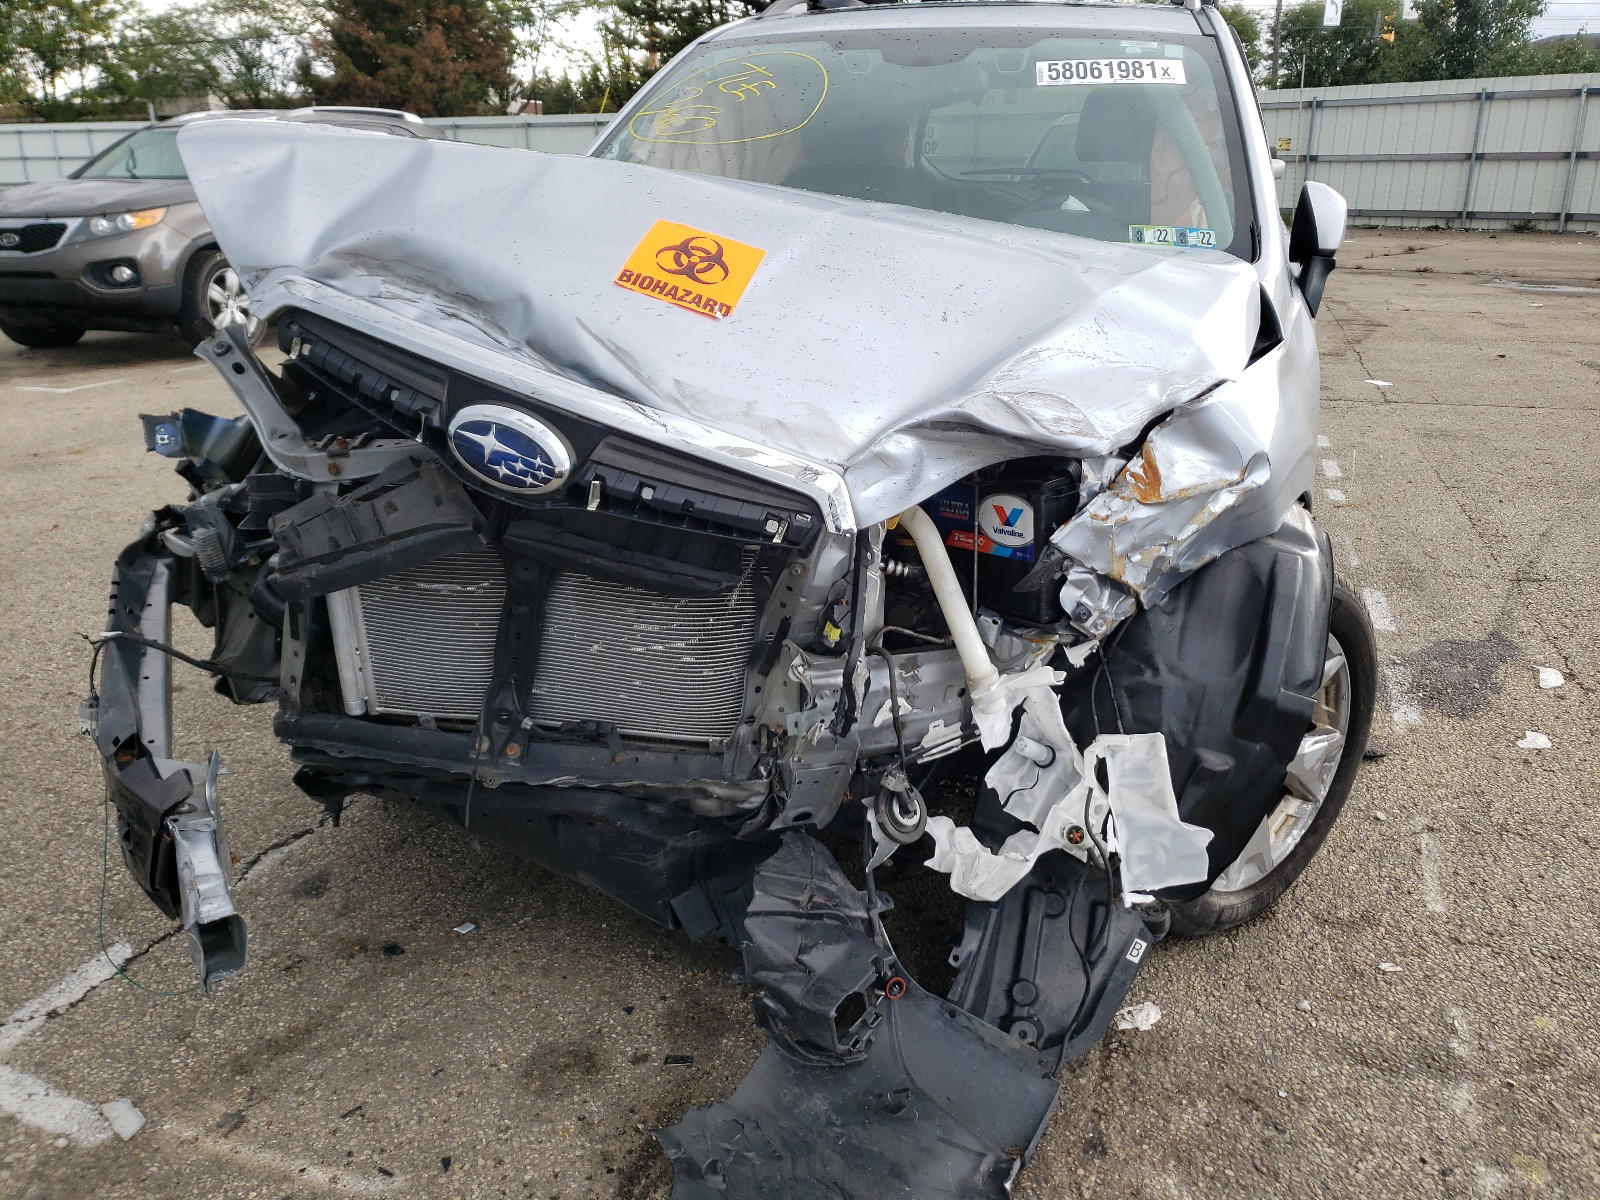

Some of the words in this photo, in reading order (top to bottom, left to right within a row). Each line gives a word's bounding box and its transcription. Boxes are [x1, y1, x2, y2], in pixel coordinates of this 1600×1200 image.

[1047, 60, 1157, 81] 58061981
[1156, 228, 1170, 243] 22
[1199, 231, 1213, 246] 22
[616, 268, 732, 318] BIOHAZARD
[940, 499, 970, 516] ULTRA
[992, 526, 1025, 539] Valvoline
[1129, 941, 1143, 958] B
